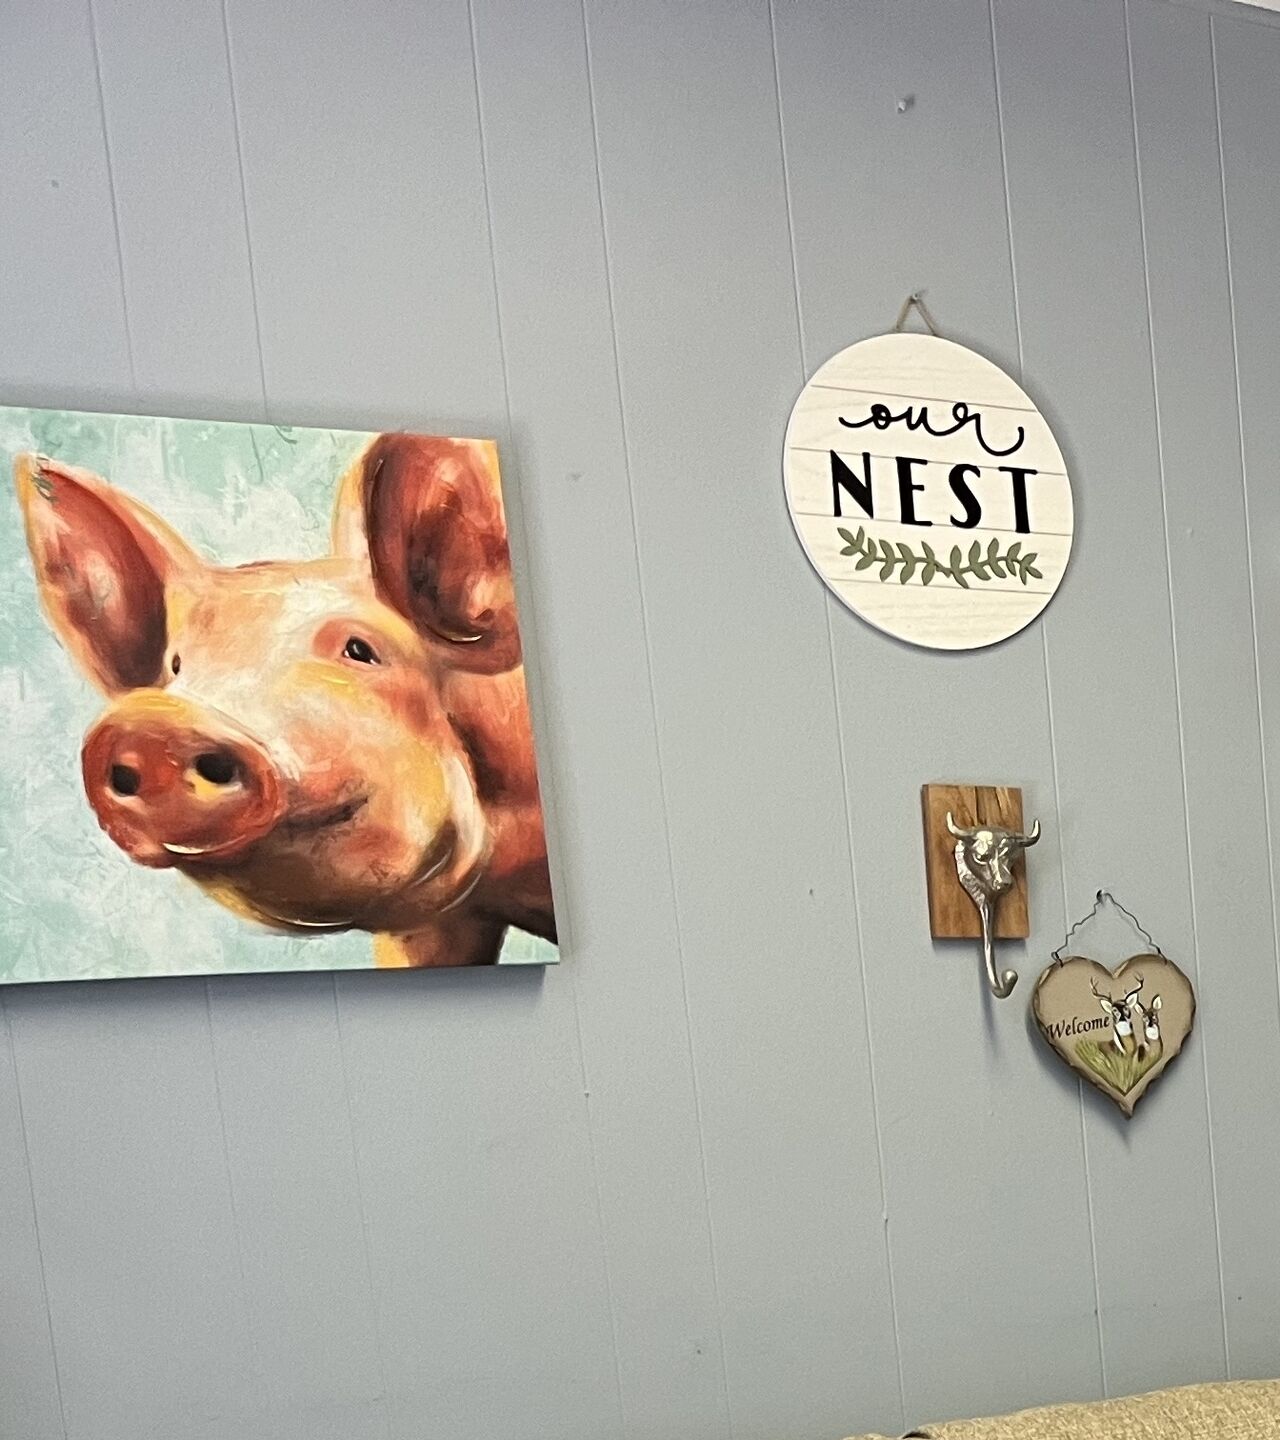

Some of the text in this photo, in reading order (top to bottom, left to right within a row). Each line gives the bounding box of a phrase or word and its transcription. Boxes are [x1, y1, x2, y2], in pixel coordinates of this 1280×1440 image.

[838, 402, 1025, 457] our
[830, 449, 1038, 534] NEST
[1047, 1016, 1110, 1040] Welcome
